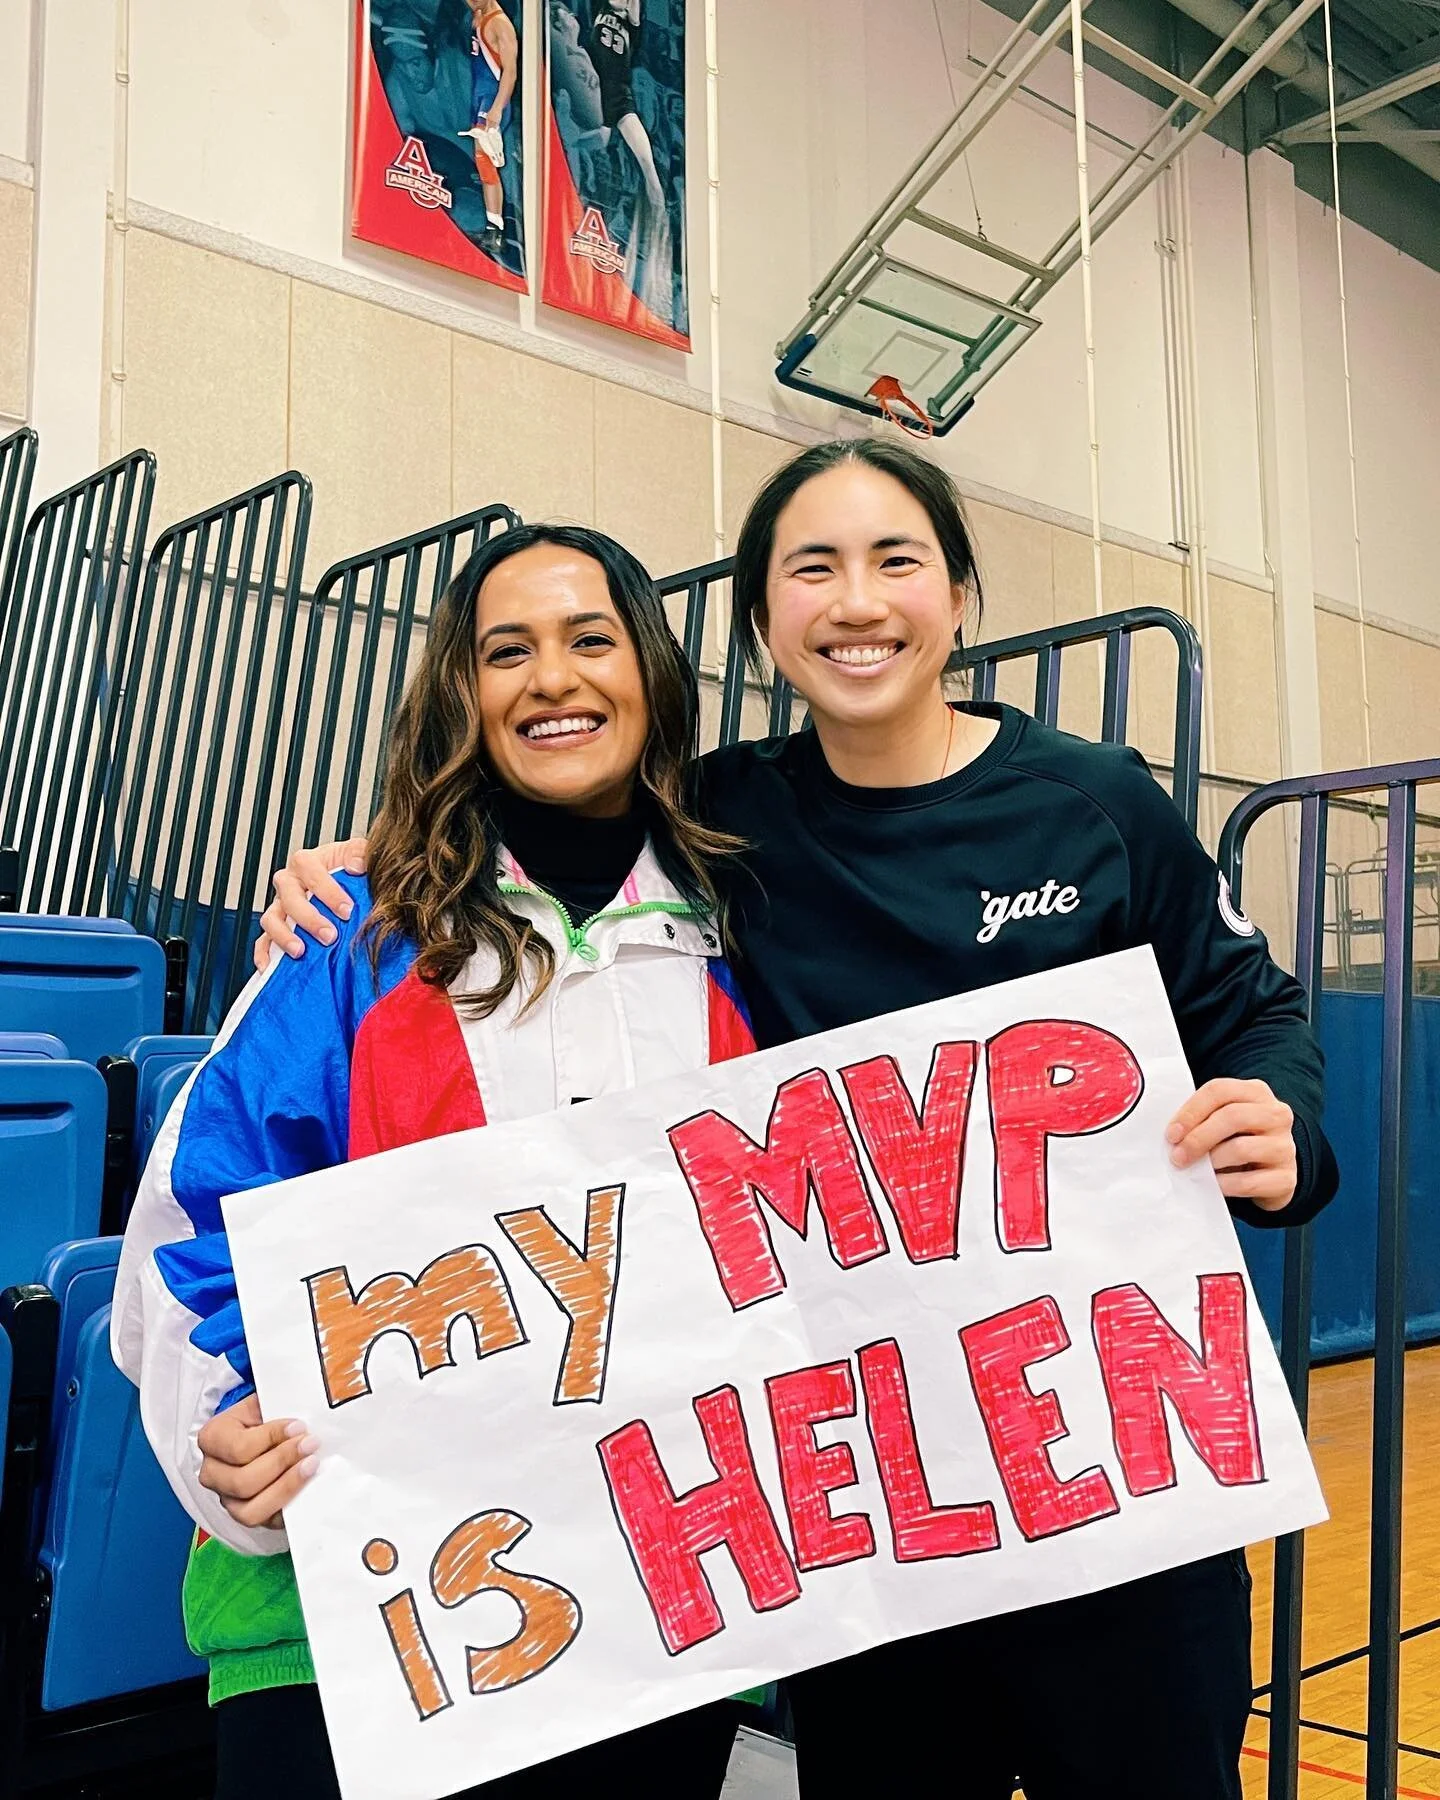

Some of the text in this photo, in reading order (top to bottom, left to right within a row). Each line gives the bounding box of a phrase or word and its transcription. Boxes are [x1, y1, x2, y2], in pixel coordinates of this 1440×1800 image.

[600, 27, 624, 54] 33
[389, 173, 449, 203] AMERICAN
[573, 241, 624, 267] AMERICAN
[667, 1018, 1145, 1312] MVP
[596, 1272, 1269, 1656] HELEN
